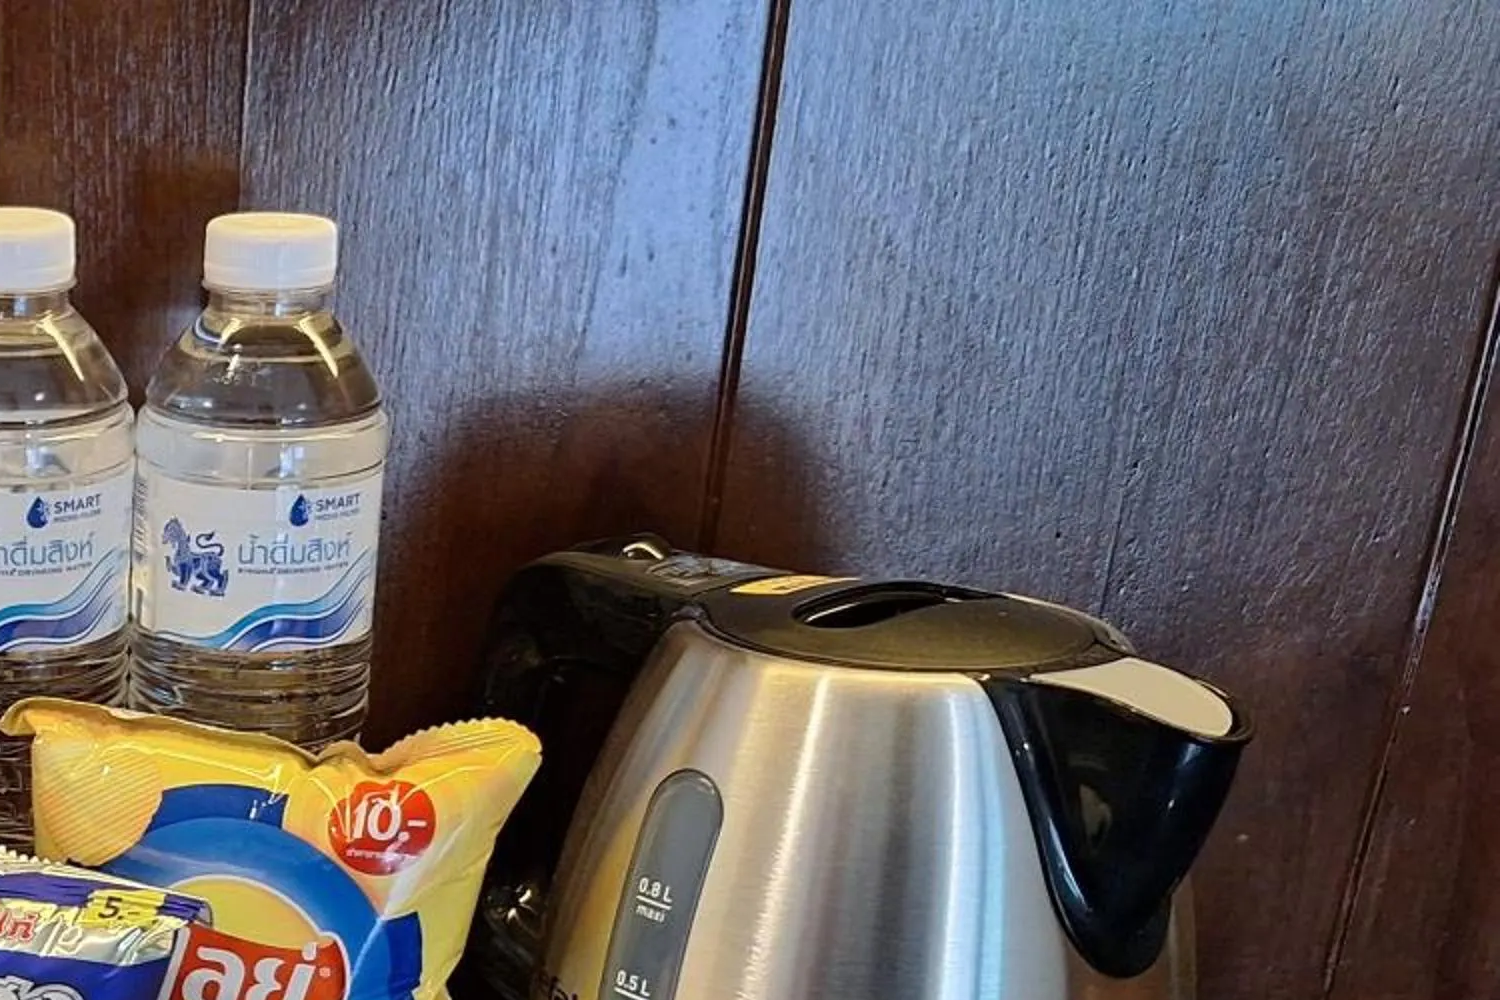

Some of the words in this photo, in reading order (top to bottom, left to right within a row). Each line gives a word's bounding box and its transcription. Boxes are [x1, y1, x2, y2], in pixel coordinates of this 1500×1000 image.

[54, 493, 101, 514] SMART
[315, 492, 360, 513] SMART
[639, 877, 661, 897] 0.8
[662, 887, 672, 902] L
[617, 970, 638, 990] 0.5
[639, 979, 651, 996] L
